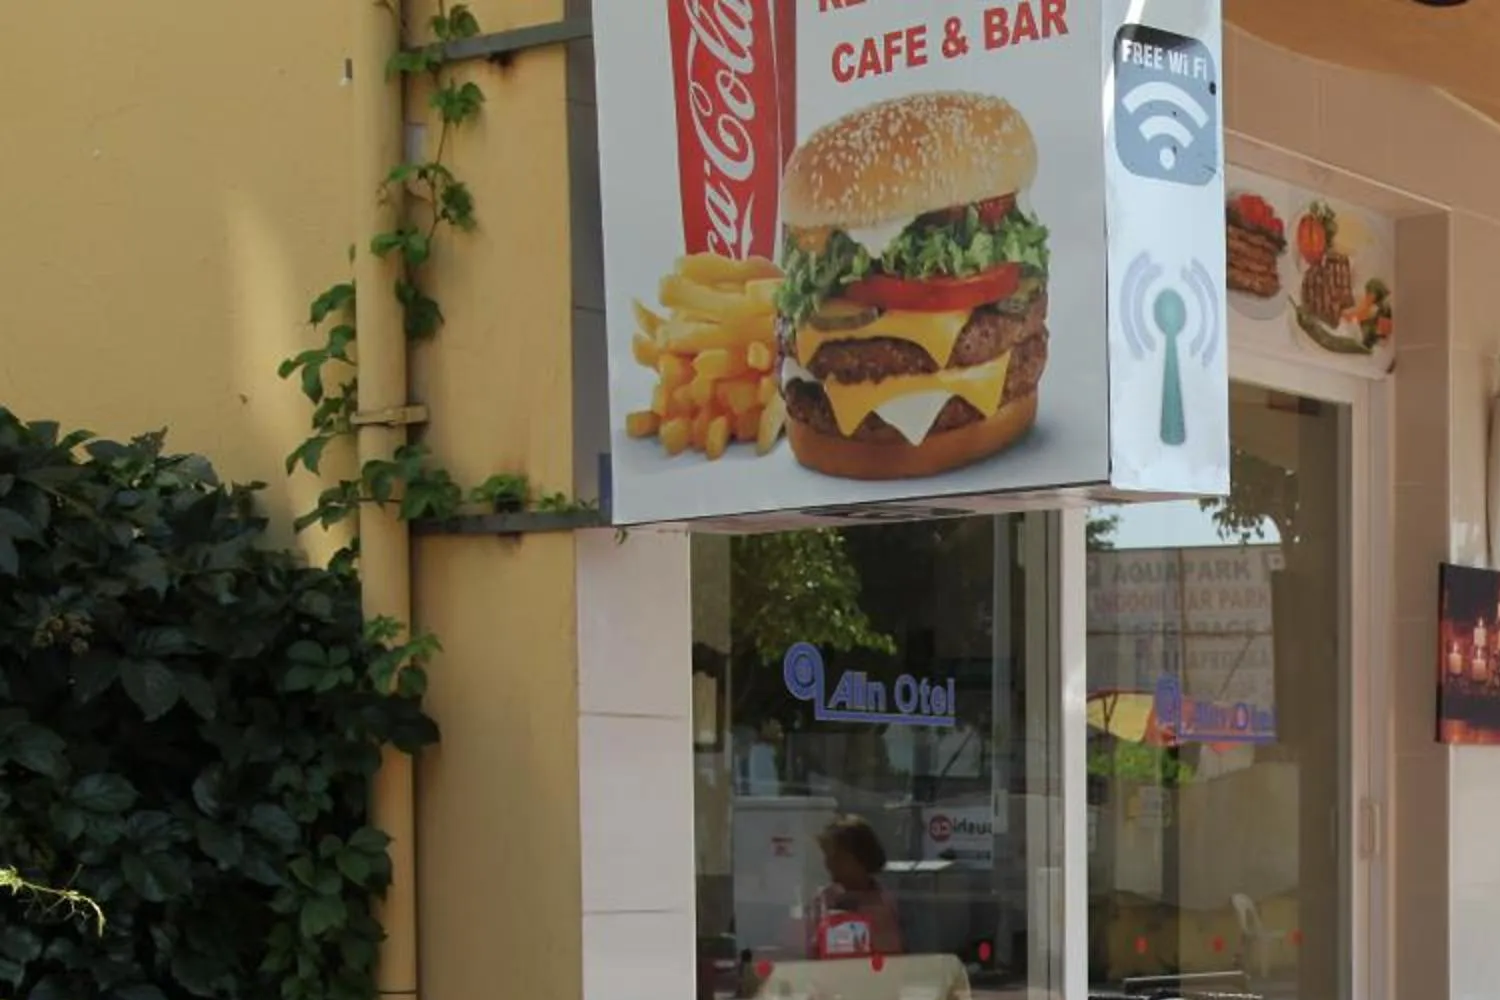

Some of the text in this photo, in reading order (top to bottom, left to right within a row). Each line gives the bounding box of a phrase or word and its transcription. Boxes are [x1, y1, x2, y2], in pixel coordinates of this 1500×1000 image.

[831, 0, 1068, 84] CAFE & BAR
[1121, 40, 1164, 70] FREE
[894, 673, 956, 715] Otel
